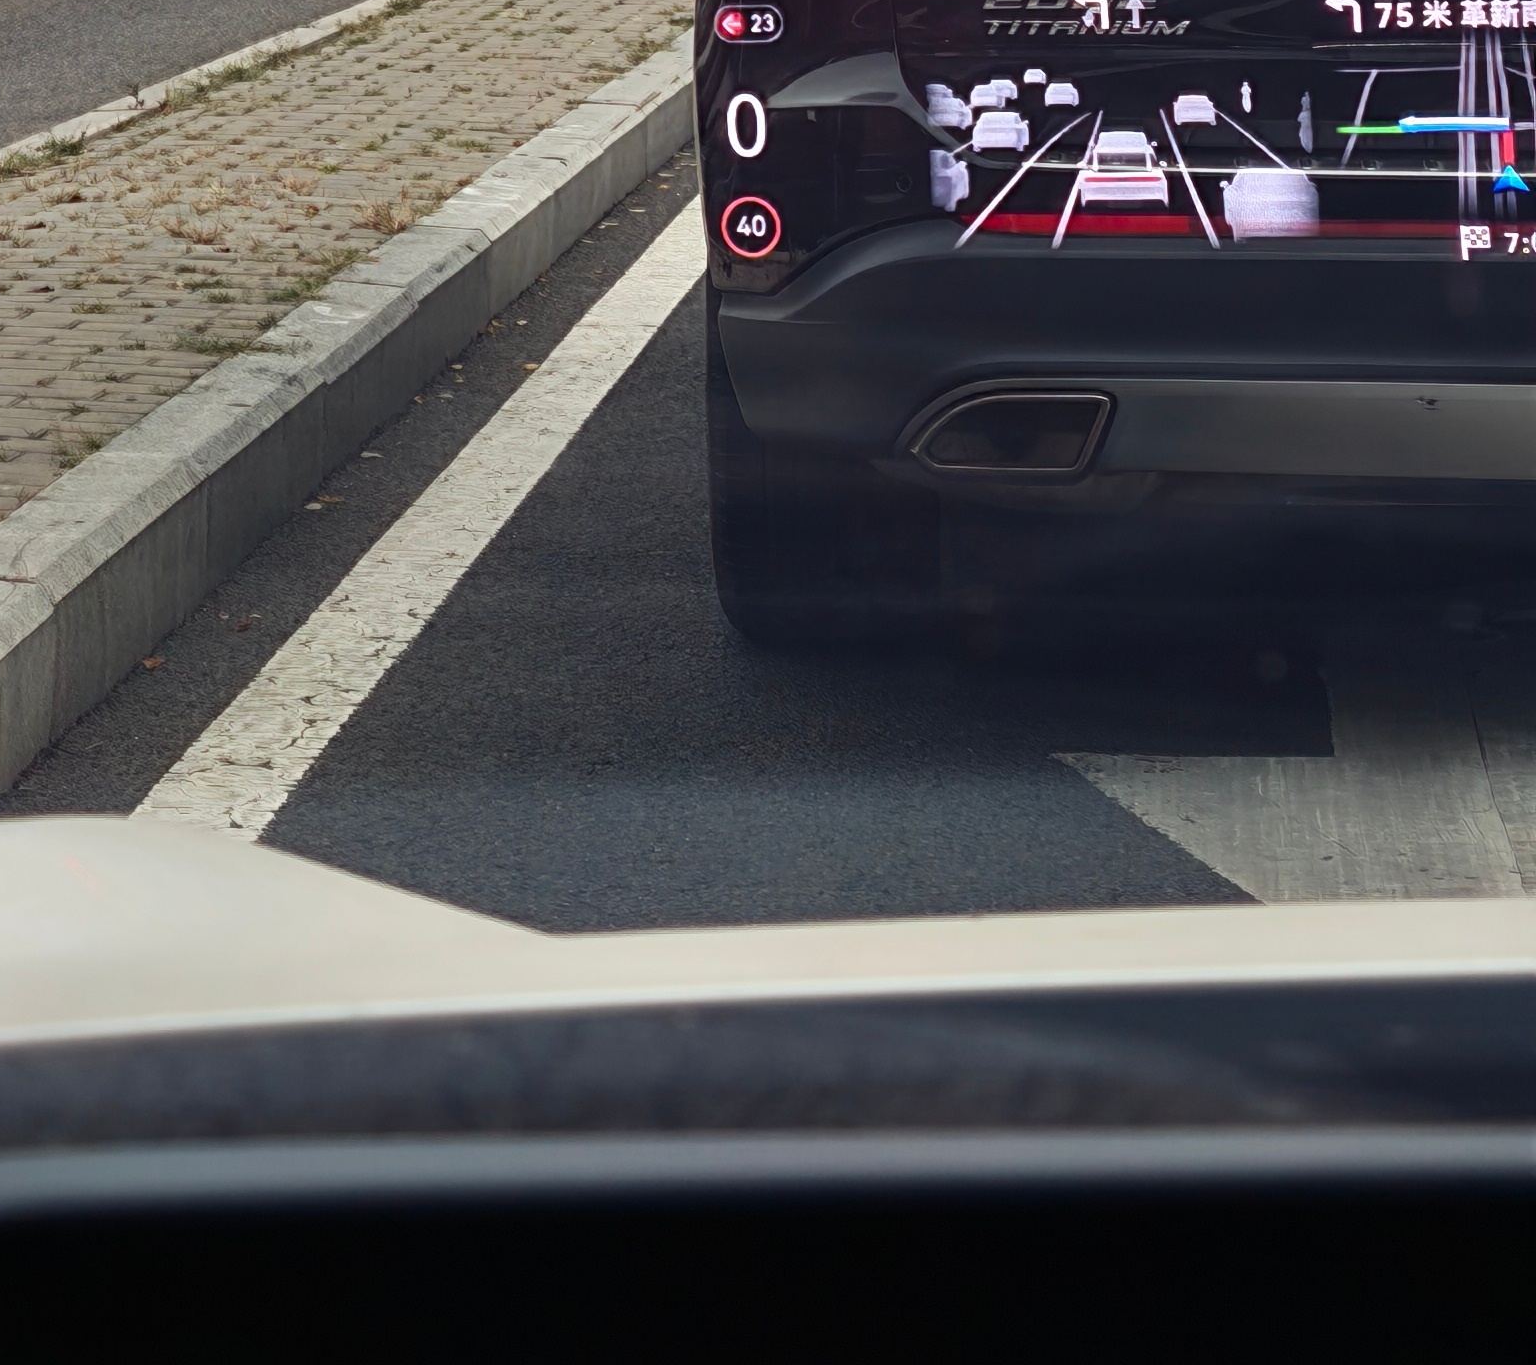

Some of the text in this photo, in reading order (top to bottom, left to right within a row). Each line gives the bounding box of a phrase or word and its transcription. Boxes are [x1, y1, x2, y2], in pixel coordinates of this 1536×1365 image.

[750, 14, 775, 33] 23
[1374, 2, 1414, 29] 75
[1422, 0, 1453, 29] 米
[726, 93, 766, 158] 0
[736, 215, 766, 237] 40
